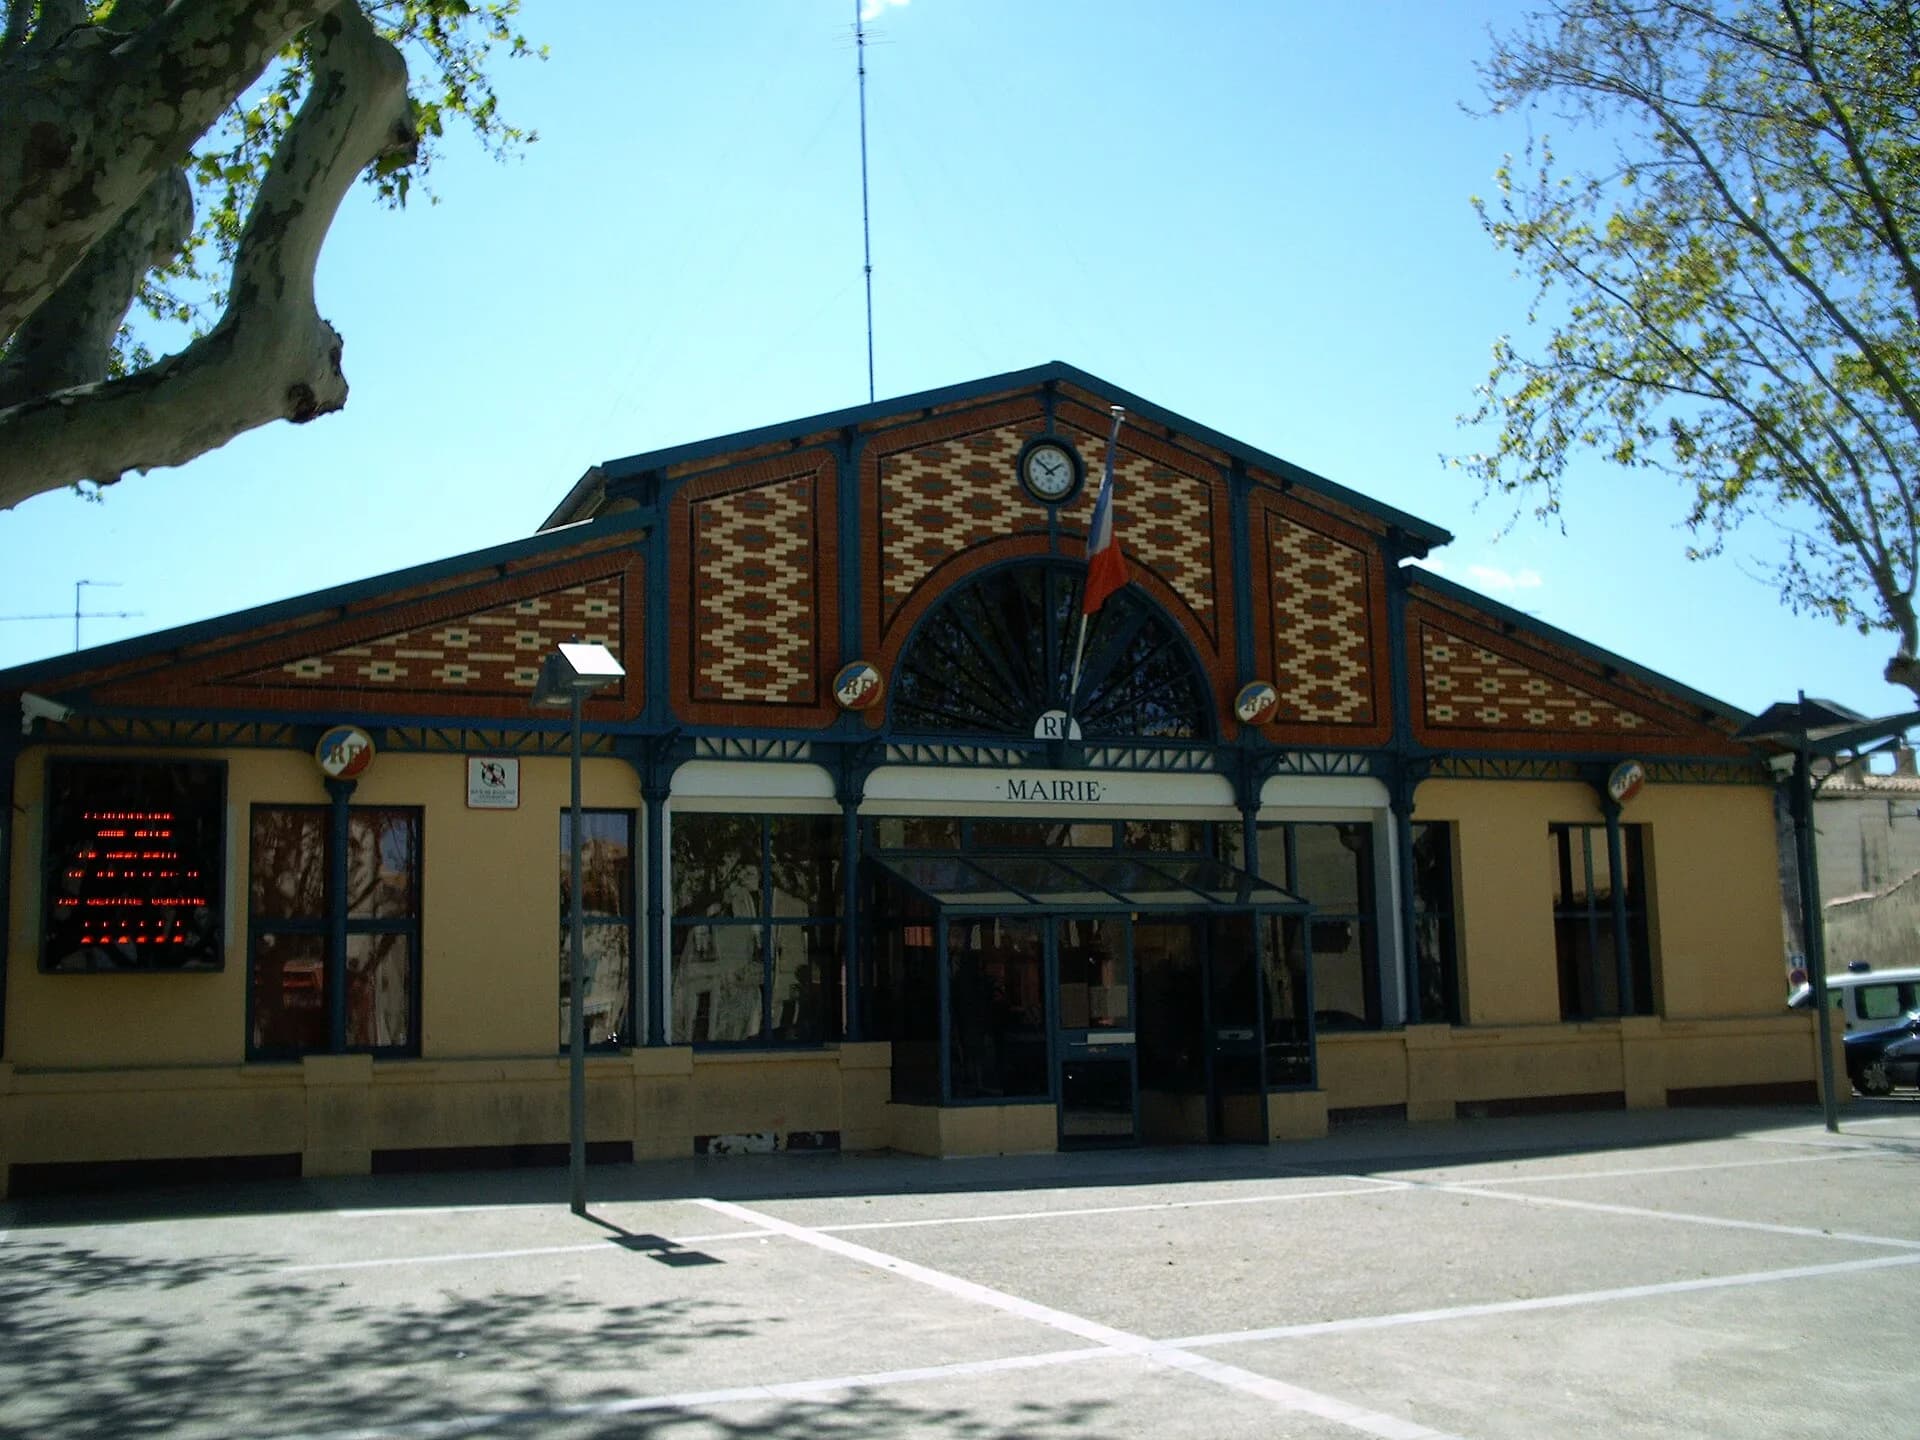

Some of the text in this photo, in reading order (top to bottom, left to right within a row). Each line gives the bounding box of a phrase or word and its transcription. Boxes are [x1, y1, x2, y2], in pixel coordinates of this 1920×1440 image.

[843, 677, 874, 696] RF
[329, 743, 364, 765] RF
[1007, 779, 1101, 802] MAIRIE
